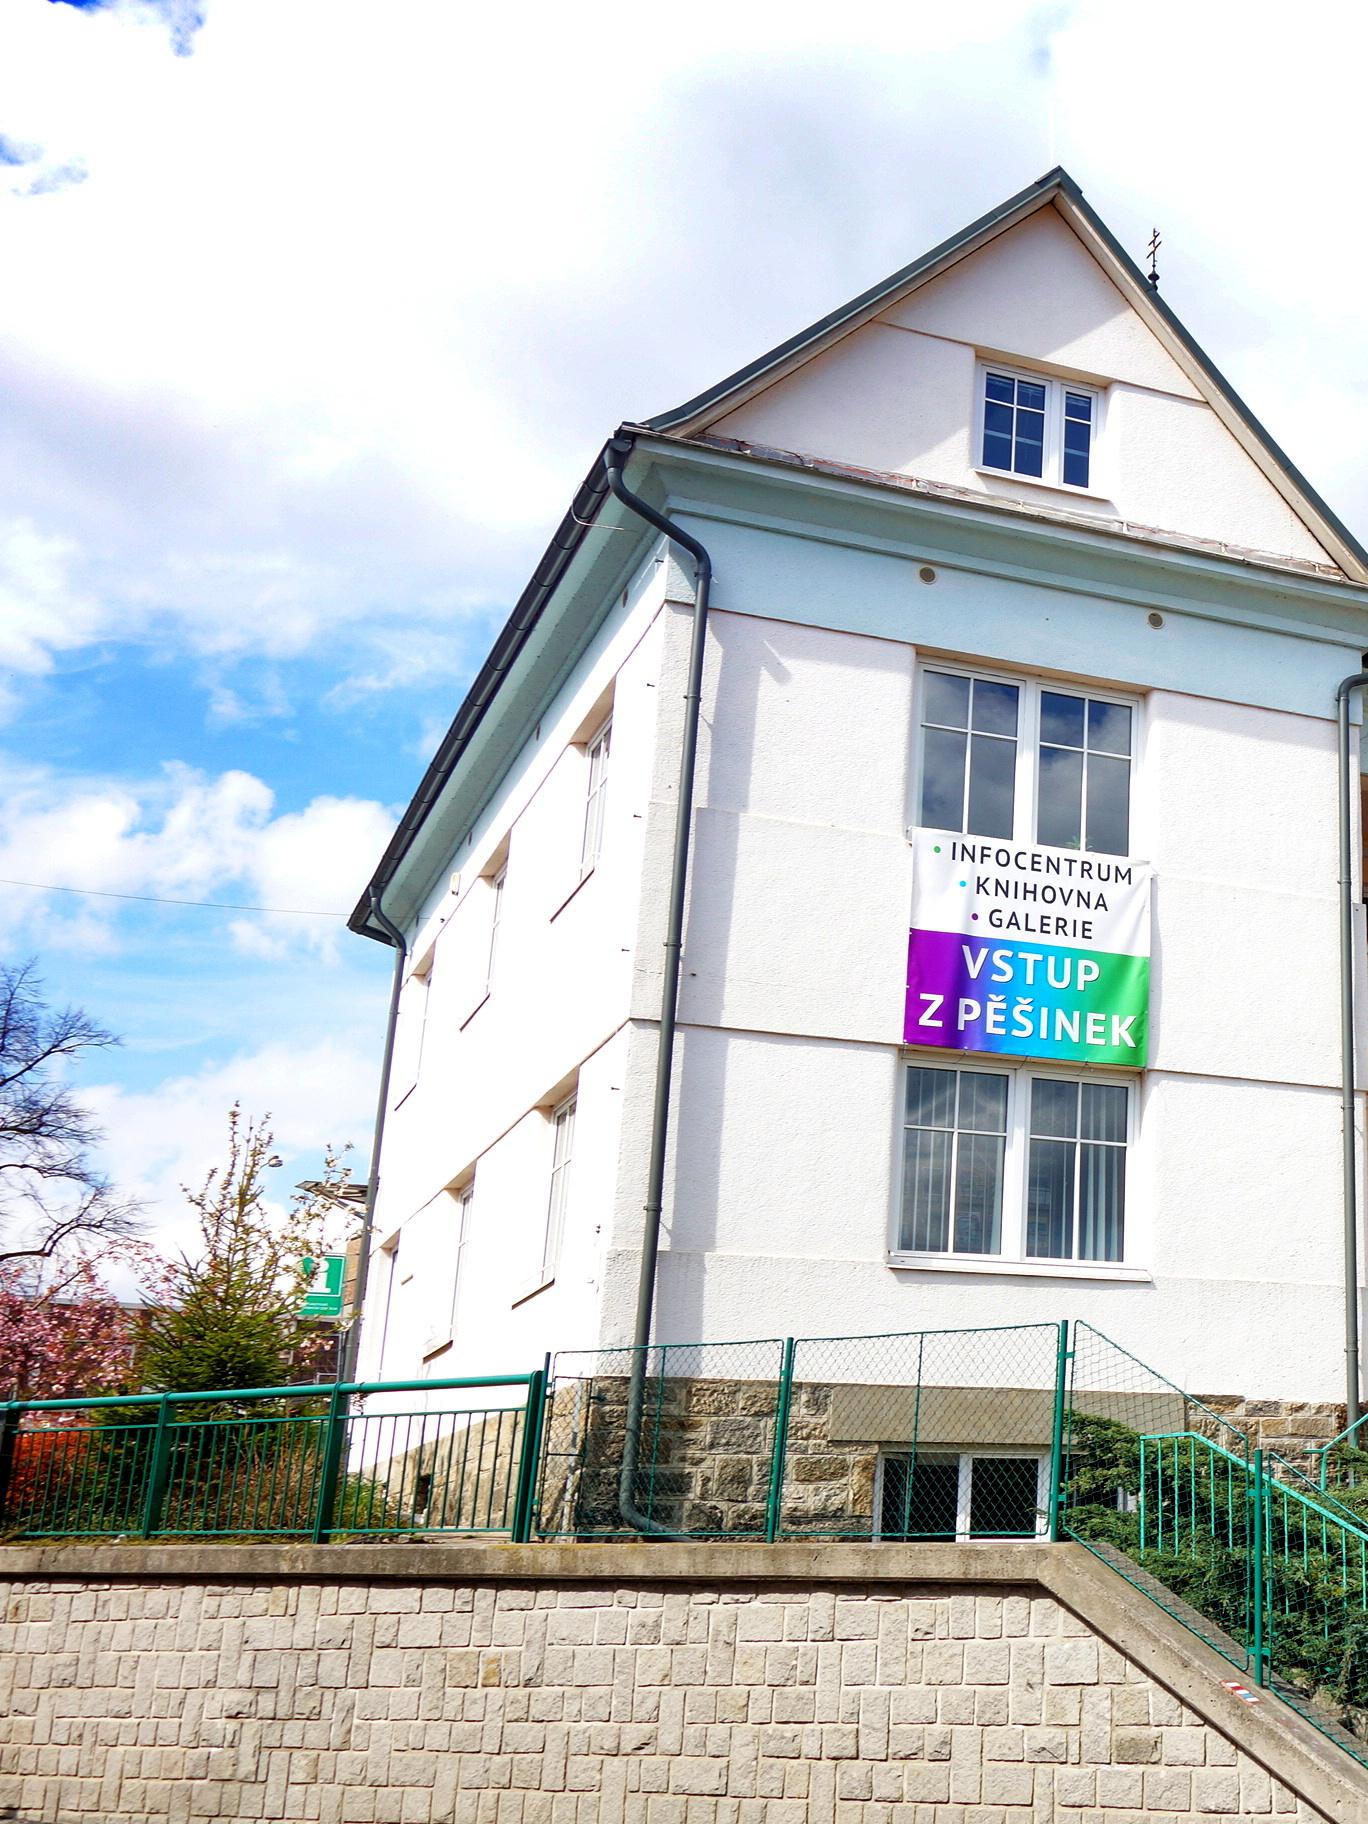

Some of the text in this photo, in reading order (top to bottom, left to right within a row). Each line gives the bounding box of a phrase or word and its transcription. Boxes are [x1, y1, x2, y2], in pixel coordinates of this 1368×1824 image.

[951, 841, 1132, 885] INFOCENTRUM
[976, 876, 1108, 912] KNIHOVNA
[988, 908, 1093, 940] GALERIE
[961, 944, 1100, 991] VSTUP
[918, 993, 1137, 1048] Z PĚŠINEK
